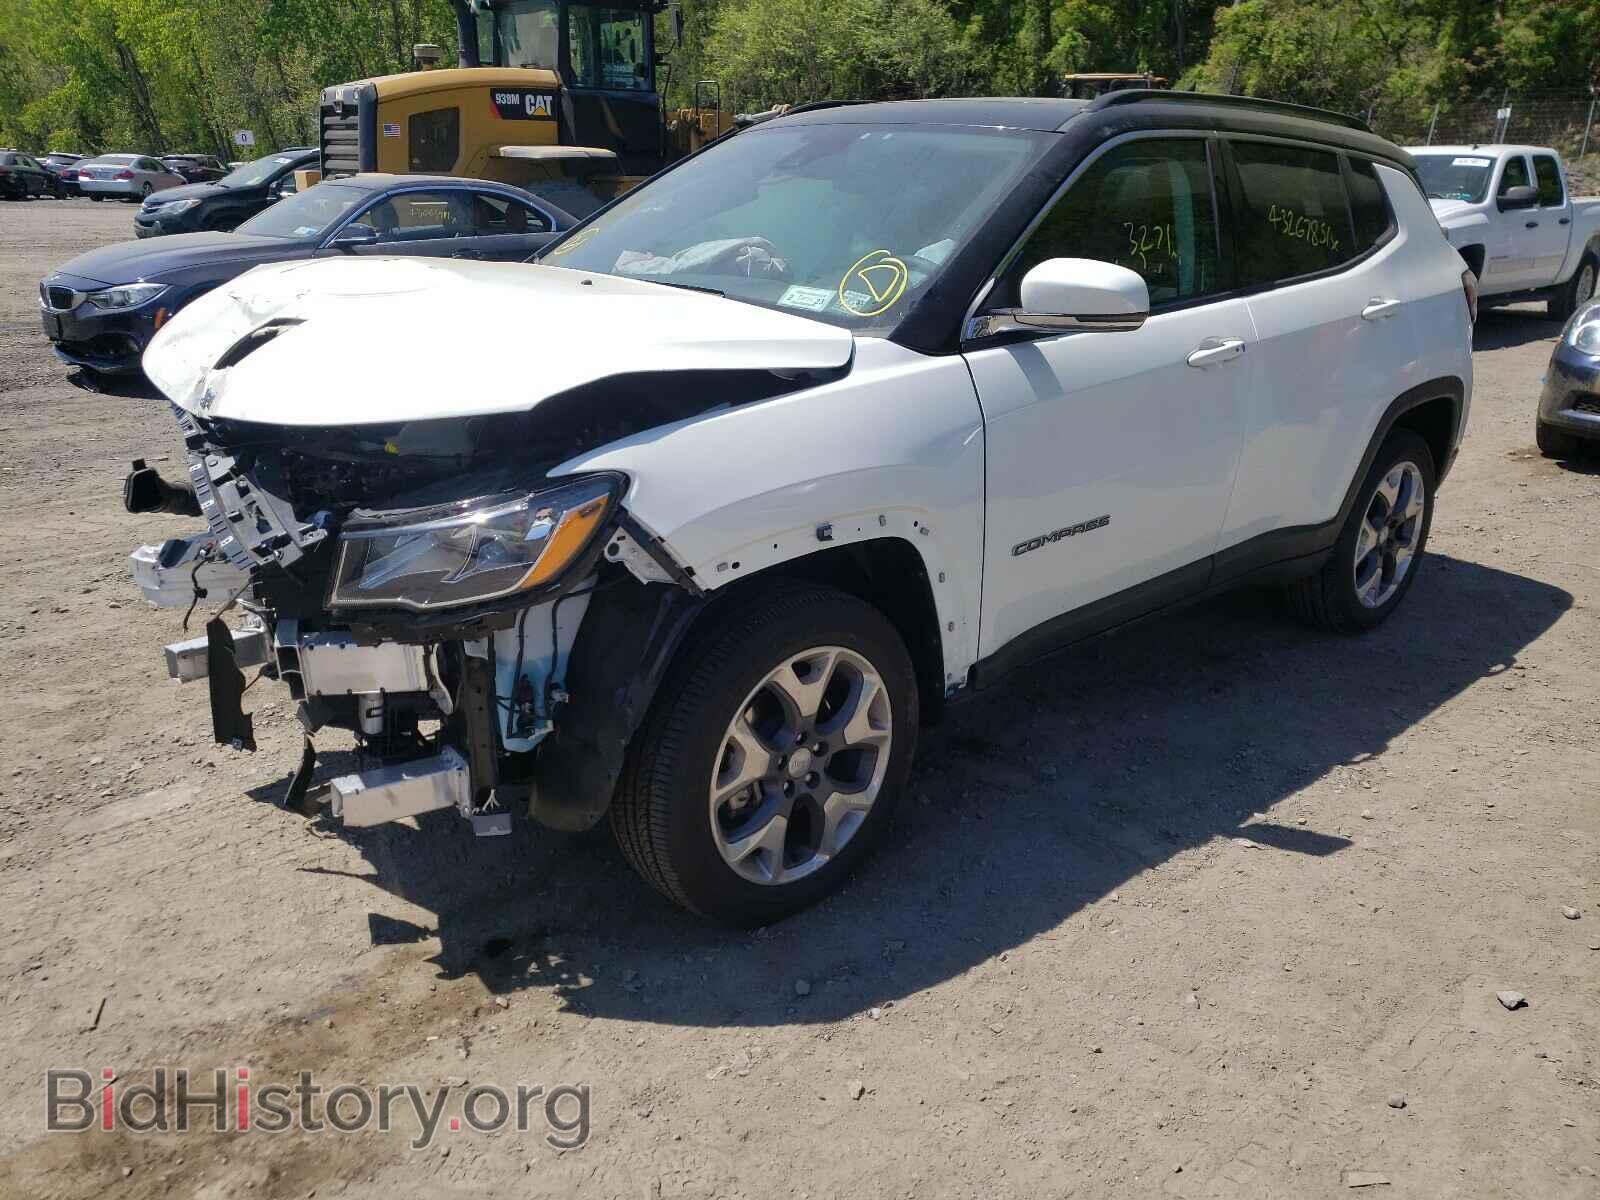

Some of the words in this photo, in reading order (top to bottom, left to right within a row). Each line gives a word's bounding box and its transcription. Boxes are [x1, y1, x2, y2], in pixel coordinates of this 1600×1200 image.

[495, 93, 520, 105] 938M
[525, 94, 553, 116] CAT
[1012, 514, 1111, 556] COMPASS
